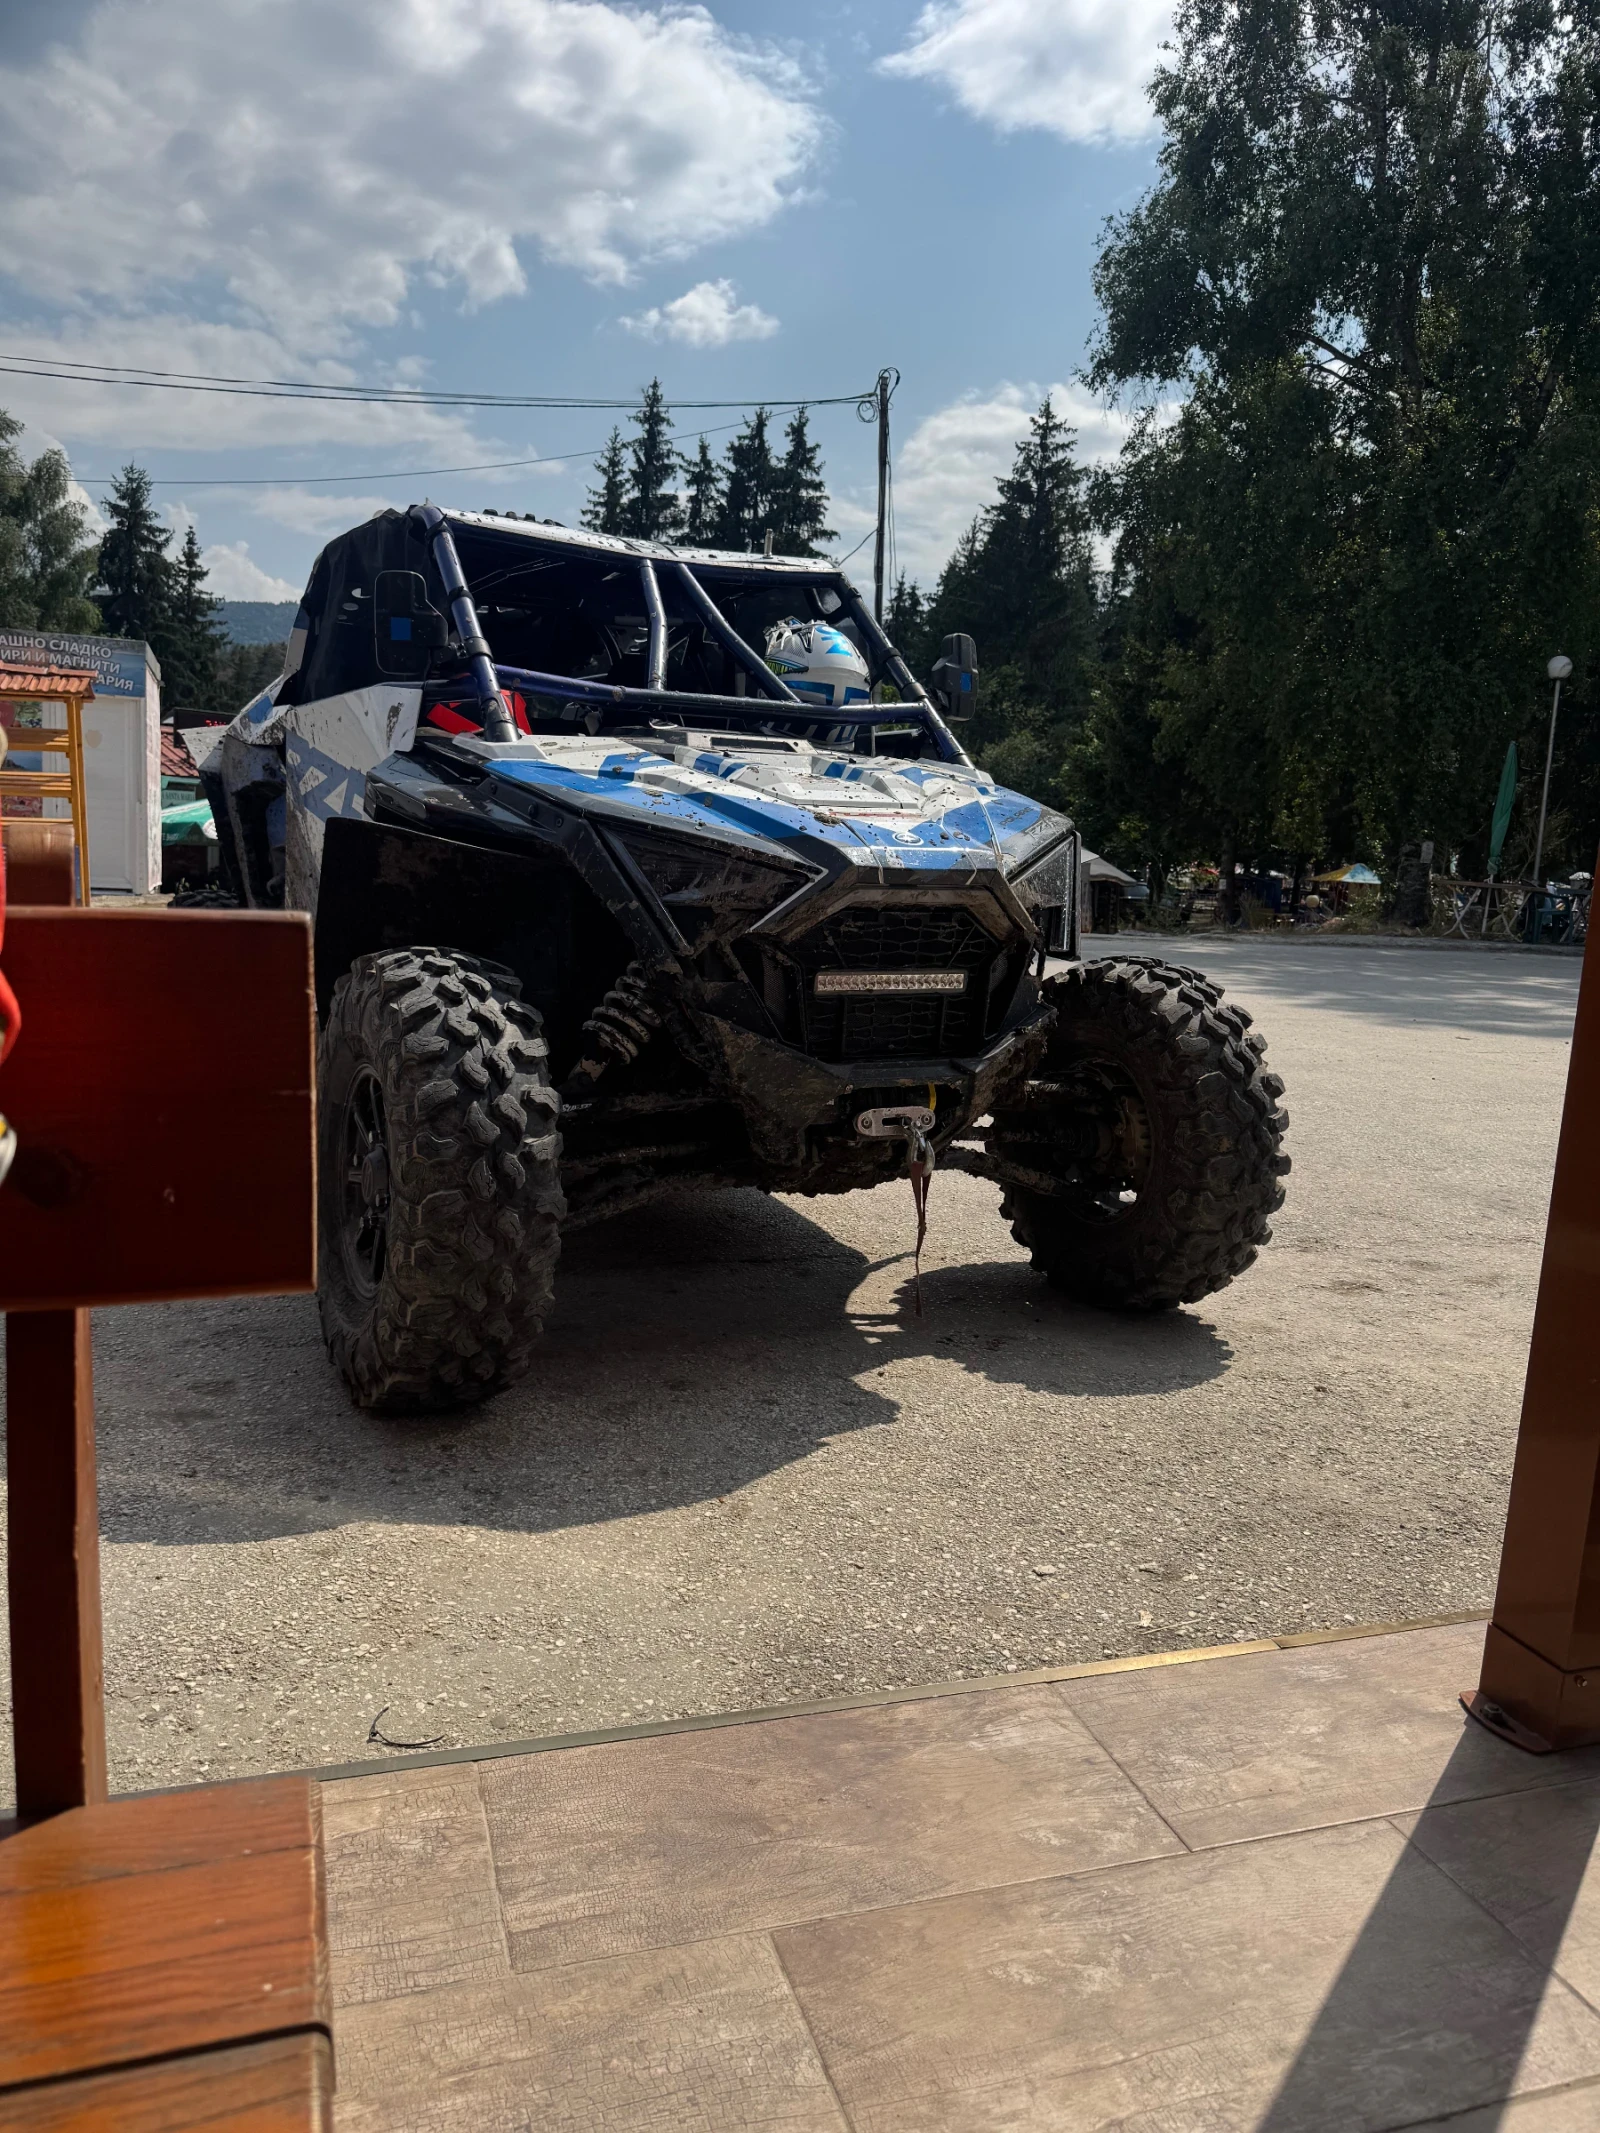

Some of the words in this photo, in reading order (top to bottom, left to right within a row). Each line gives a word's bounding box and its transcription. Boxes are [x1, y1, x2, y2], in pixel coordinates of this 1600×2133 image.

[49, 639, 112, 658] СЛАДКО
[35, 652, 46, 663] И
[49, 653, 121, 675] МАГНИТИ
[91, 674, 134, 691] АРИЯ
